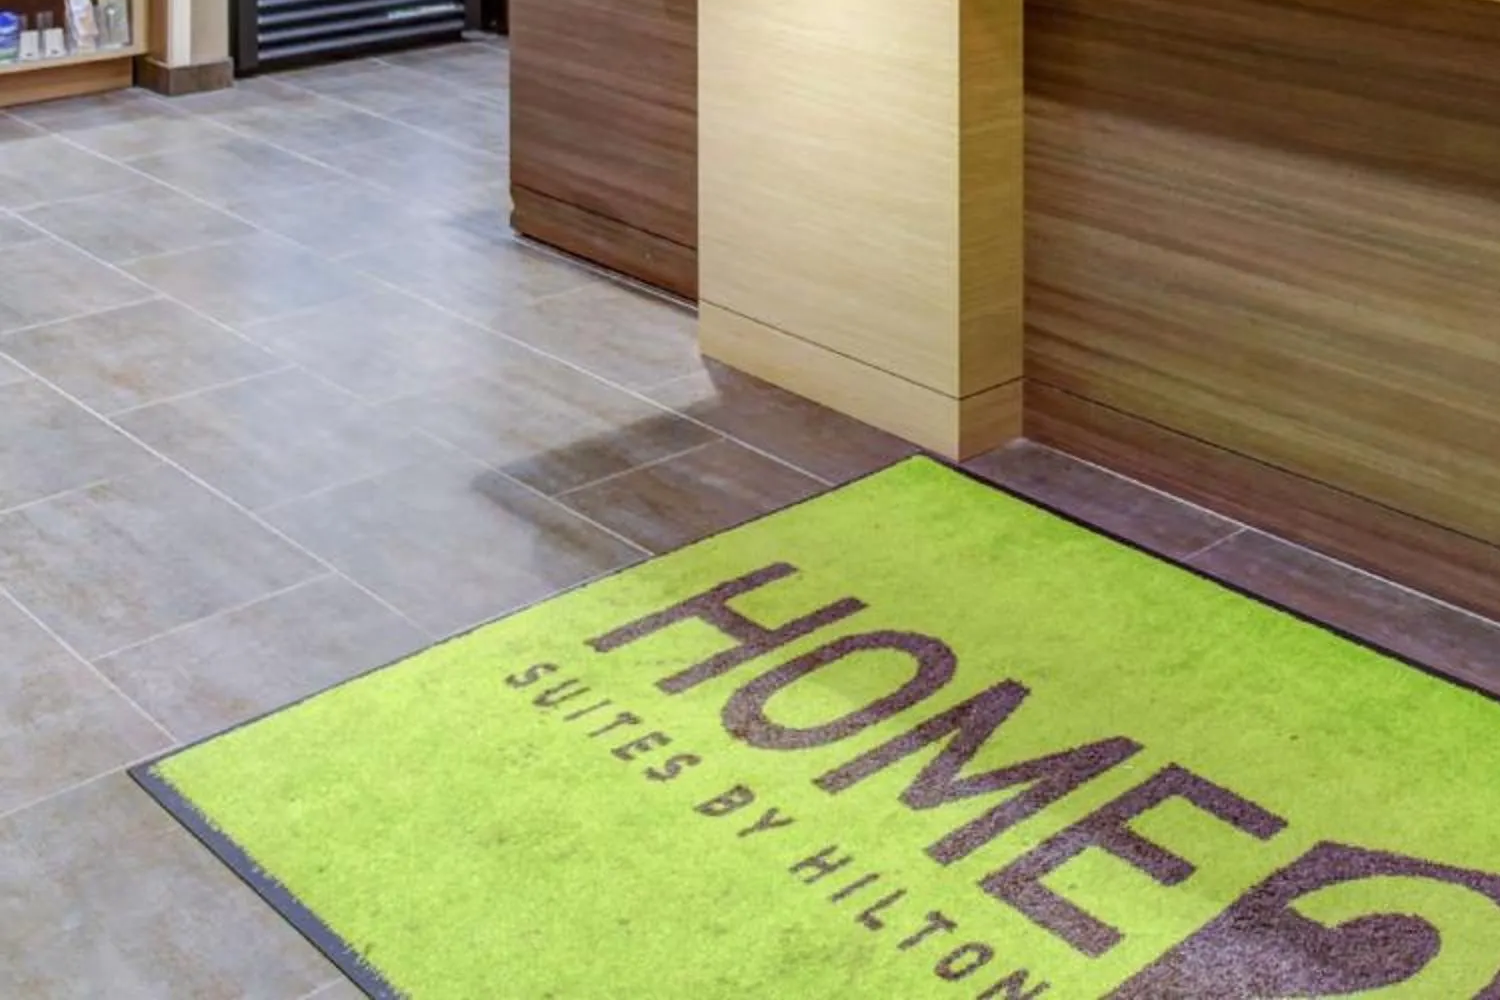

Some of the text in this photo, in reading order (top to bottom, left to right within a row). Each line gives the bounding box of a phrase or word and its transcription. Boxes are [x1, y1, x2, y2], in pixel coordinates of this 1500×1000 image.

[504, 662, 1052, 1000] SUITES BY HILTON
[584, 561, 1289, 959] HOME
